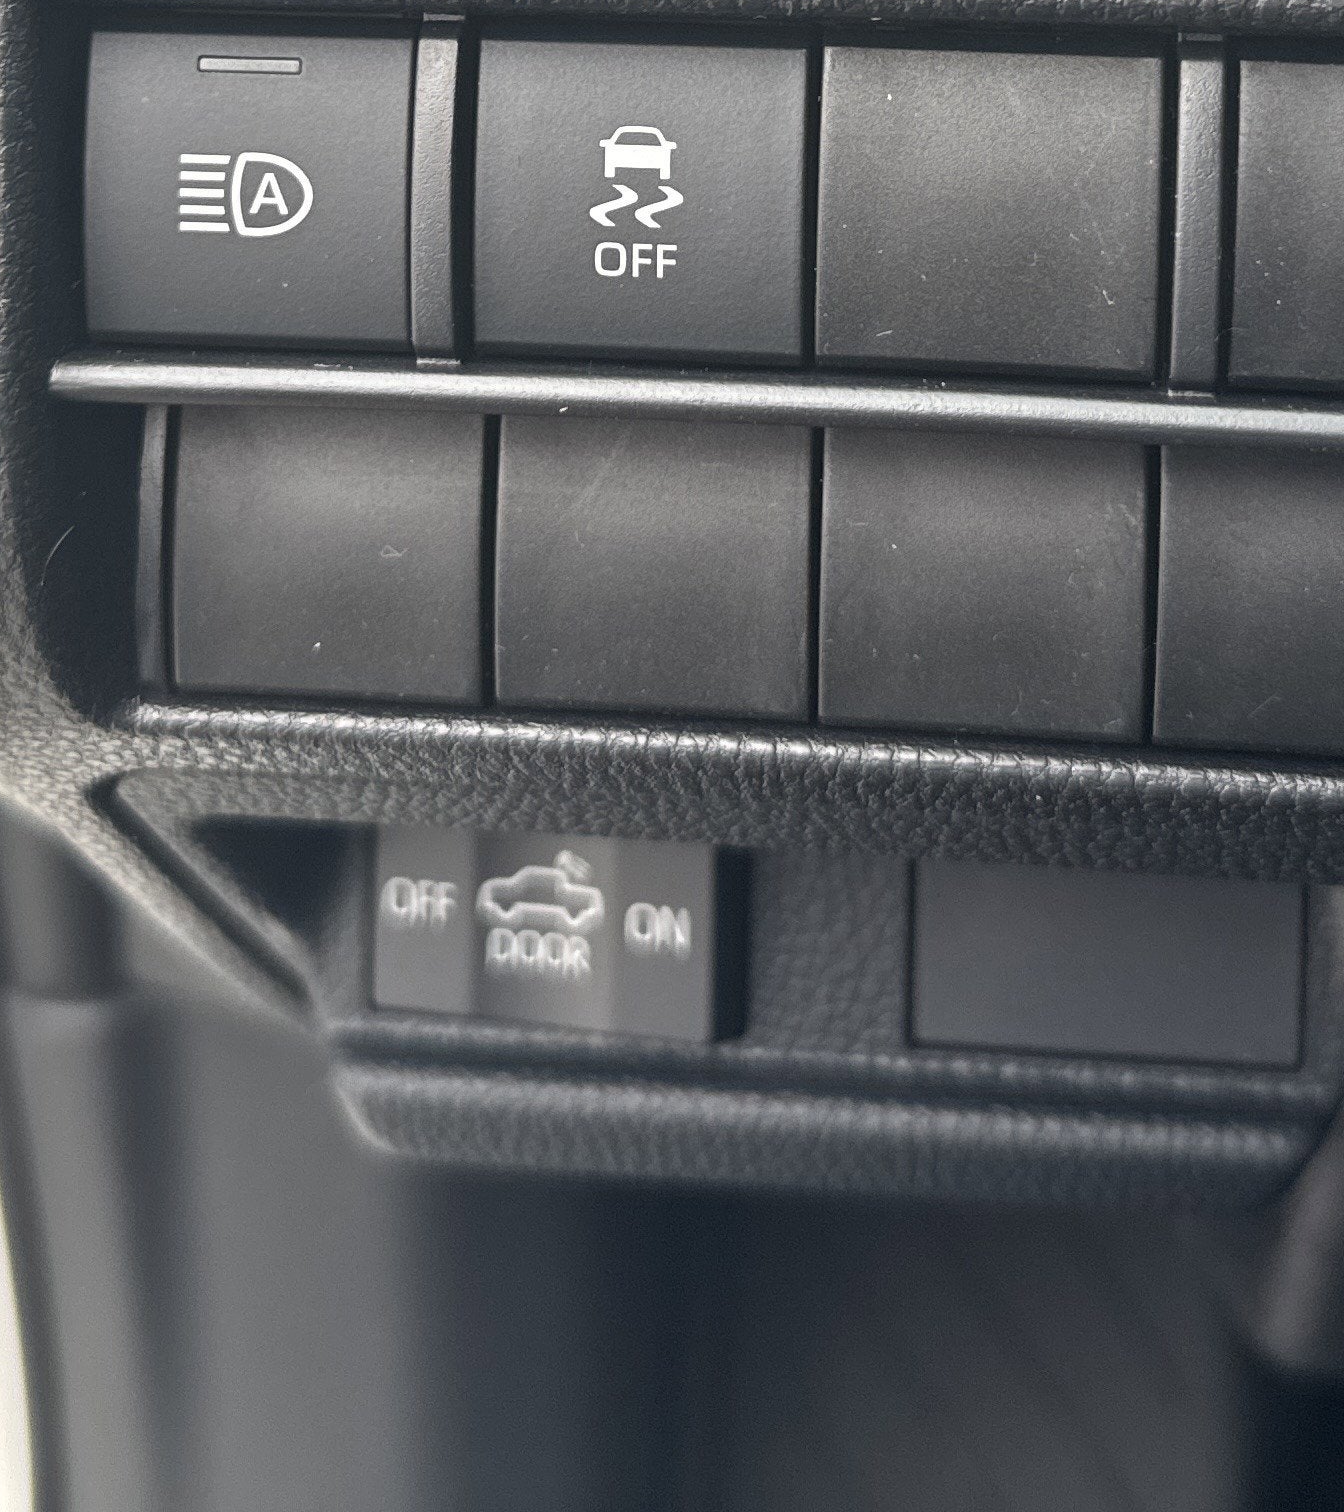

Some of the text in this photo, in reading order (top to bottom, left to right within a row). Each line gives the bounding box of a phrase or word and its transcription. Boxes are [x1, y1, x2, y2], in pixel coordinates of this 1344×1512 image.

[249, 172, 289, 215] A
[594, 241, 678, 279] OFF
[379, 875, 457, 927] OFF
[485, 927, 592, 980] DOOR
[623, 902, 692, 958] ON
